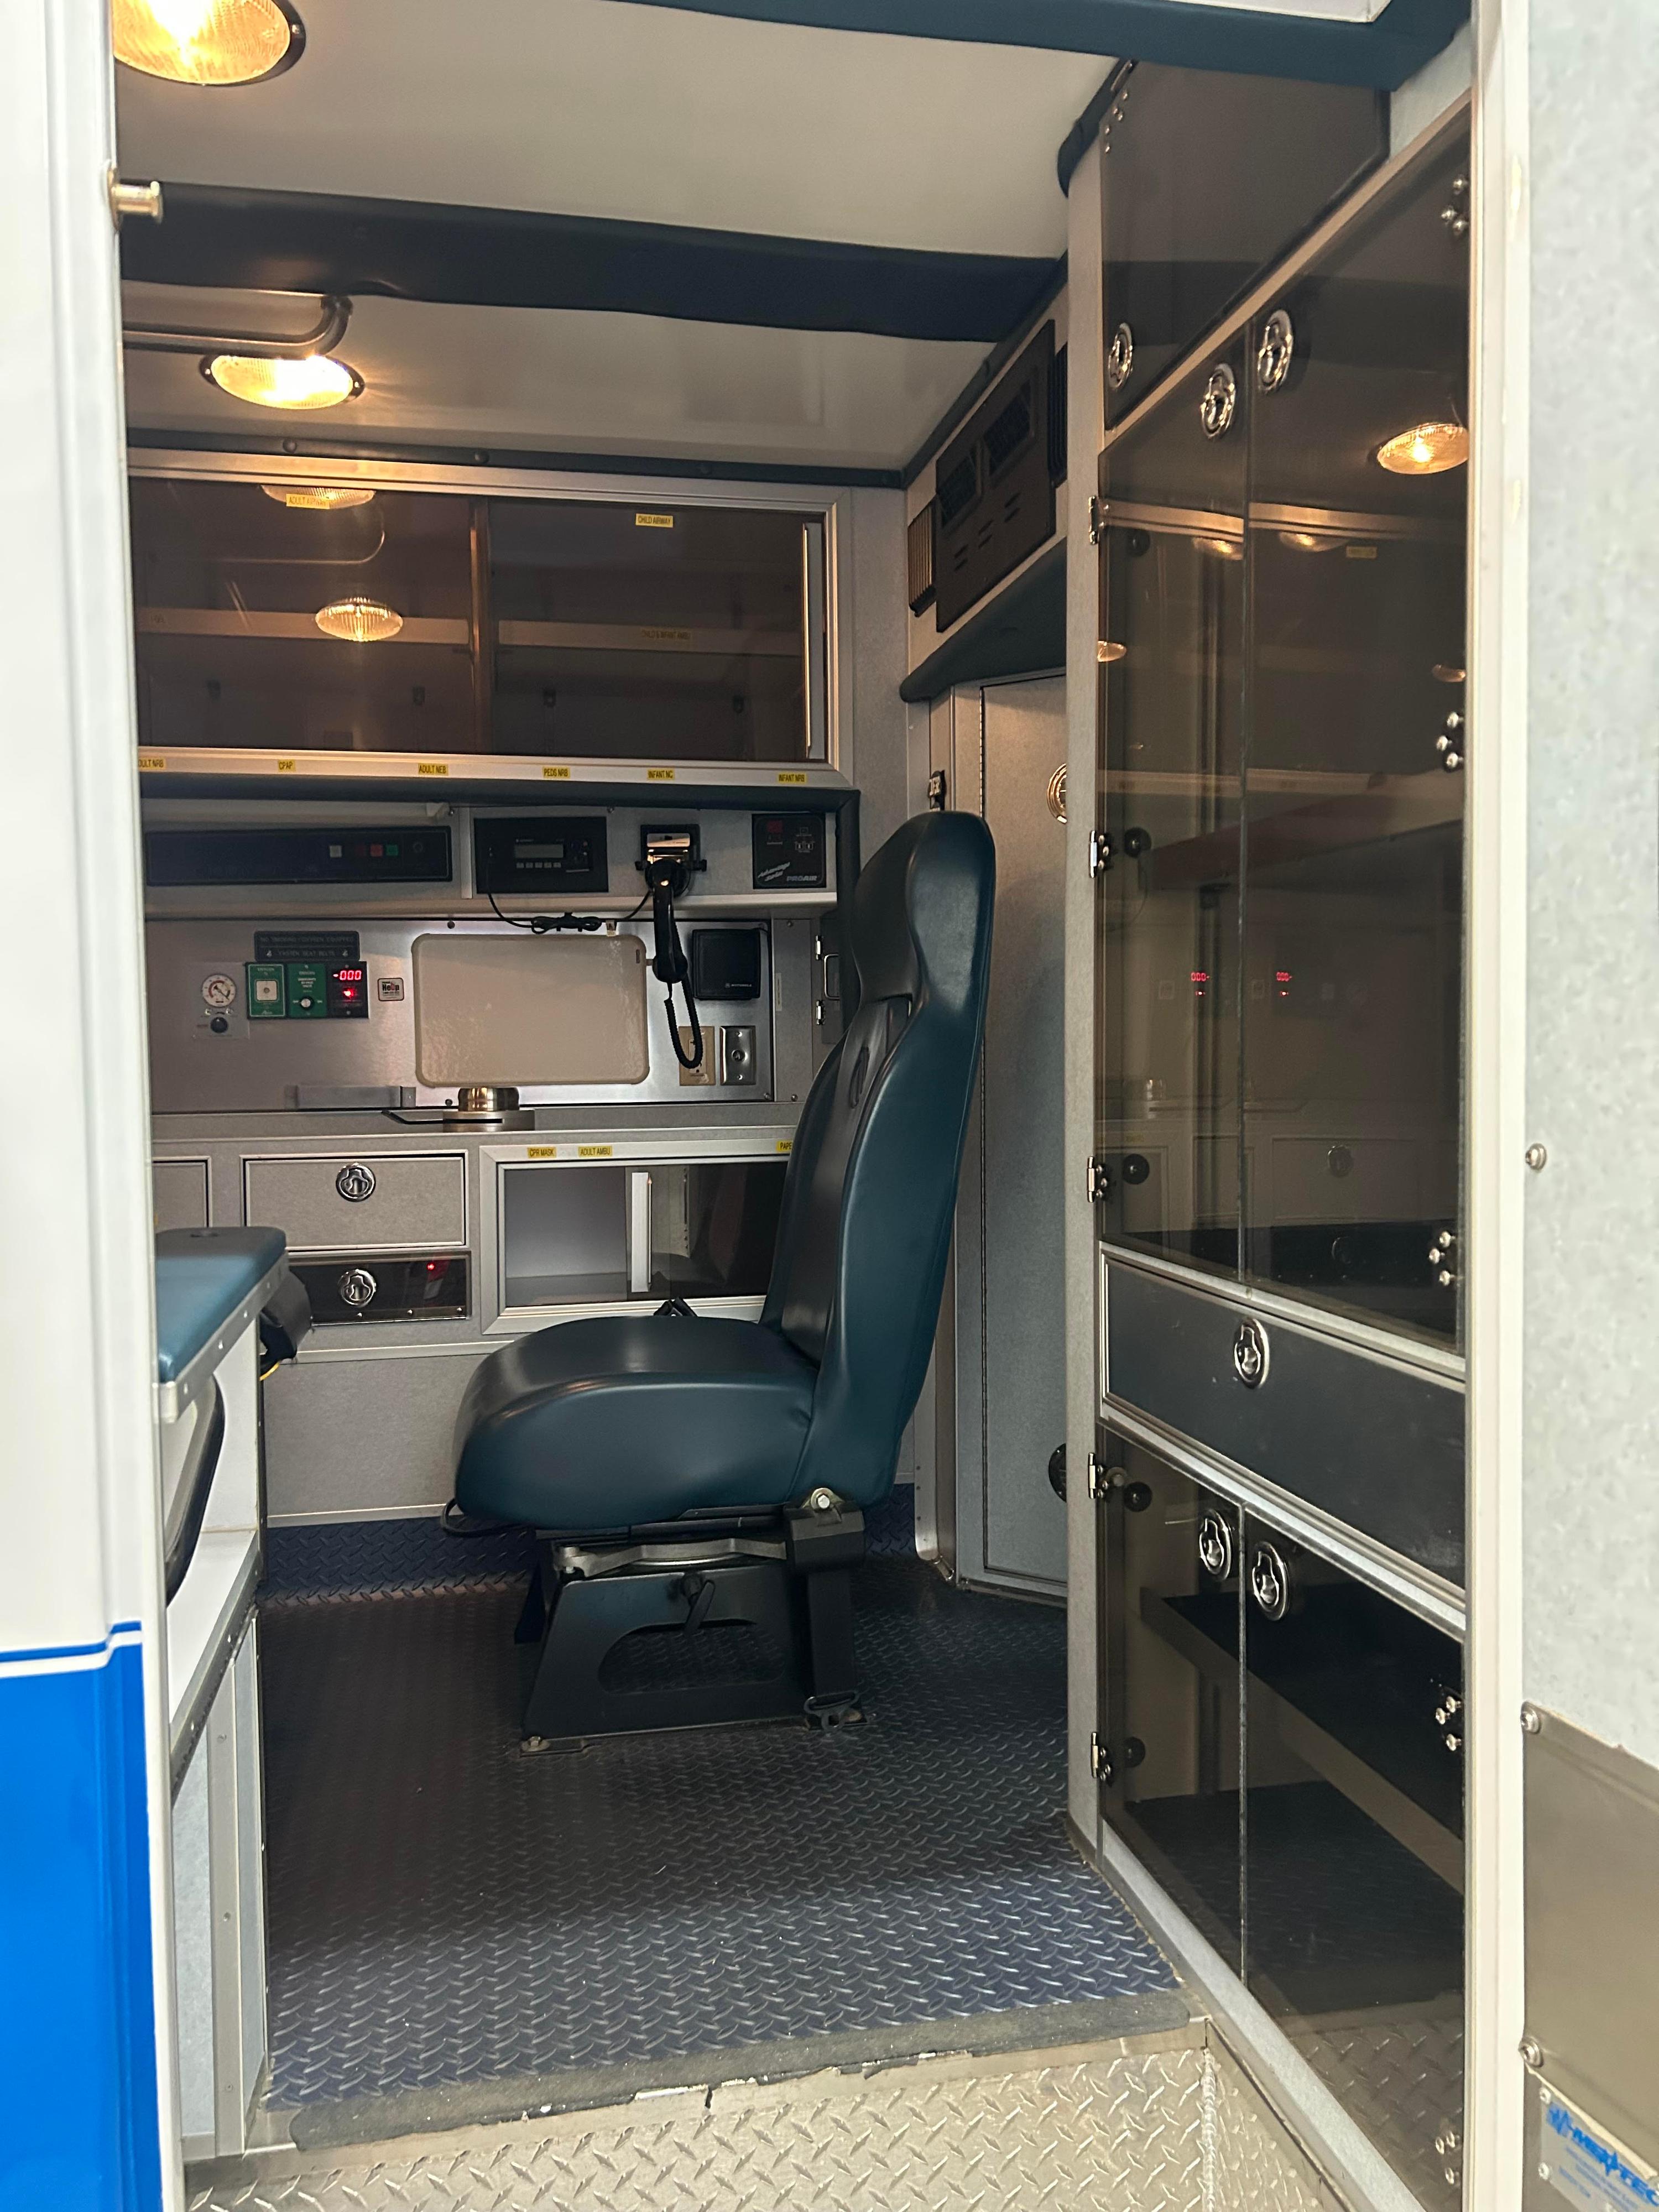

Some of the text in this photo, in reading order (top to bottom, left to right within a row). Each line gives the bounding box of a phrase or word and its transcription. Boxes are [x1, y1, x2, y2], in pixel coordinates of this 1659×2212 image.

[638, 515, 653, 524] CHILD
[138, 759, 152, 768] DULT
[279, 761, 293, 770] CPAP
[419, 764, 447, 774] ADULT NEB
[544, 768, 557, 777] PEDS
[648, 770, 665, 779] INFANT
[778, 774, 794, 782] INFANT
[780, 1141, 793, 1150] PAPE
[529, 1148, 554, 1157] CPR MASK
[581, 1147, 611, 1156] ADULT AMBU
